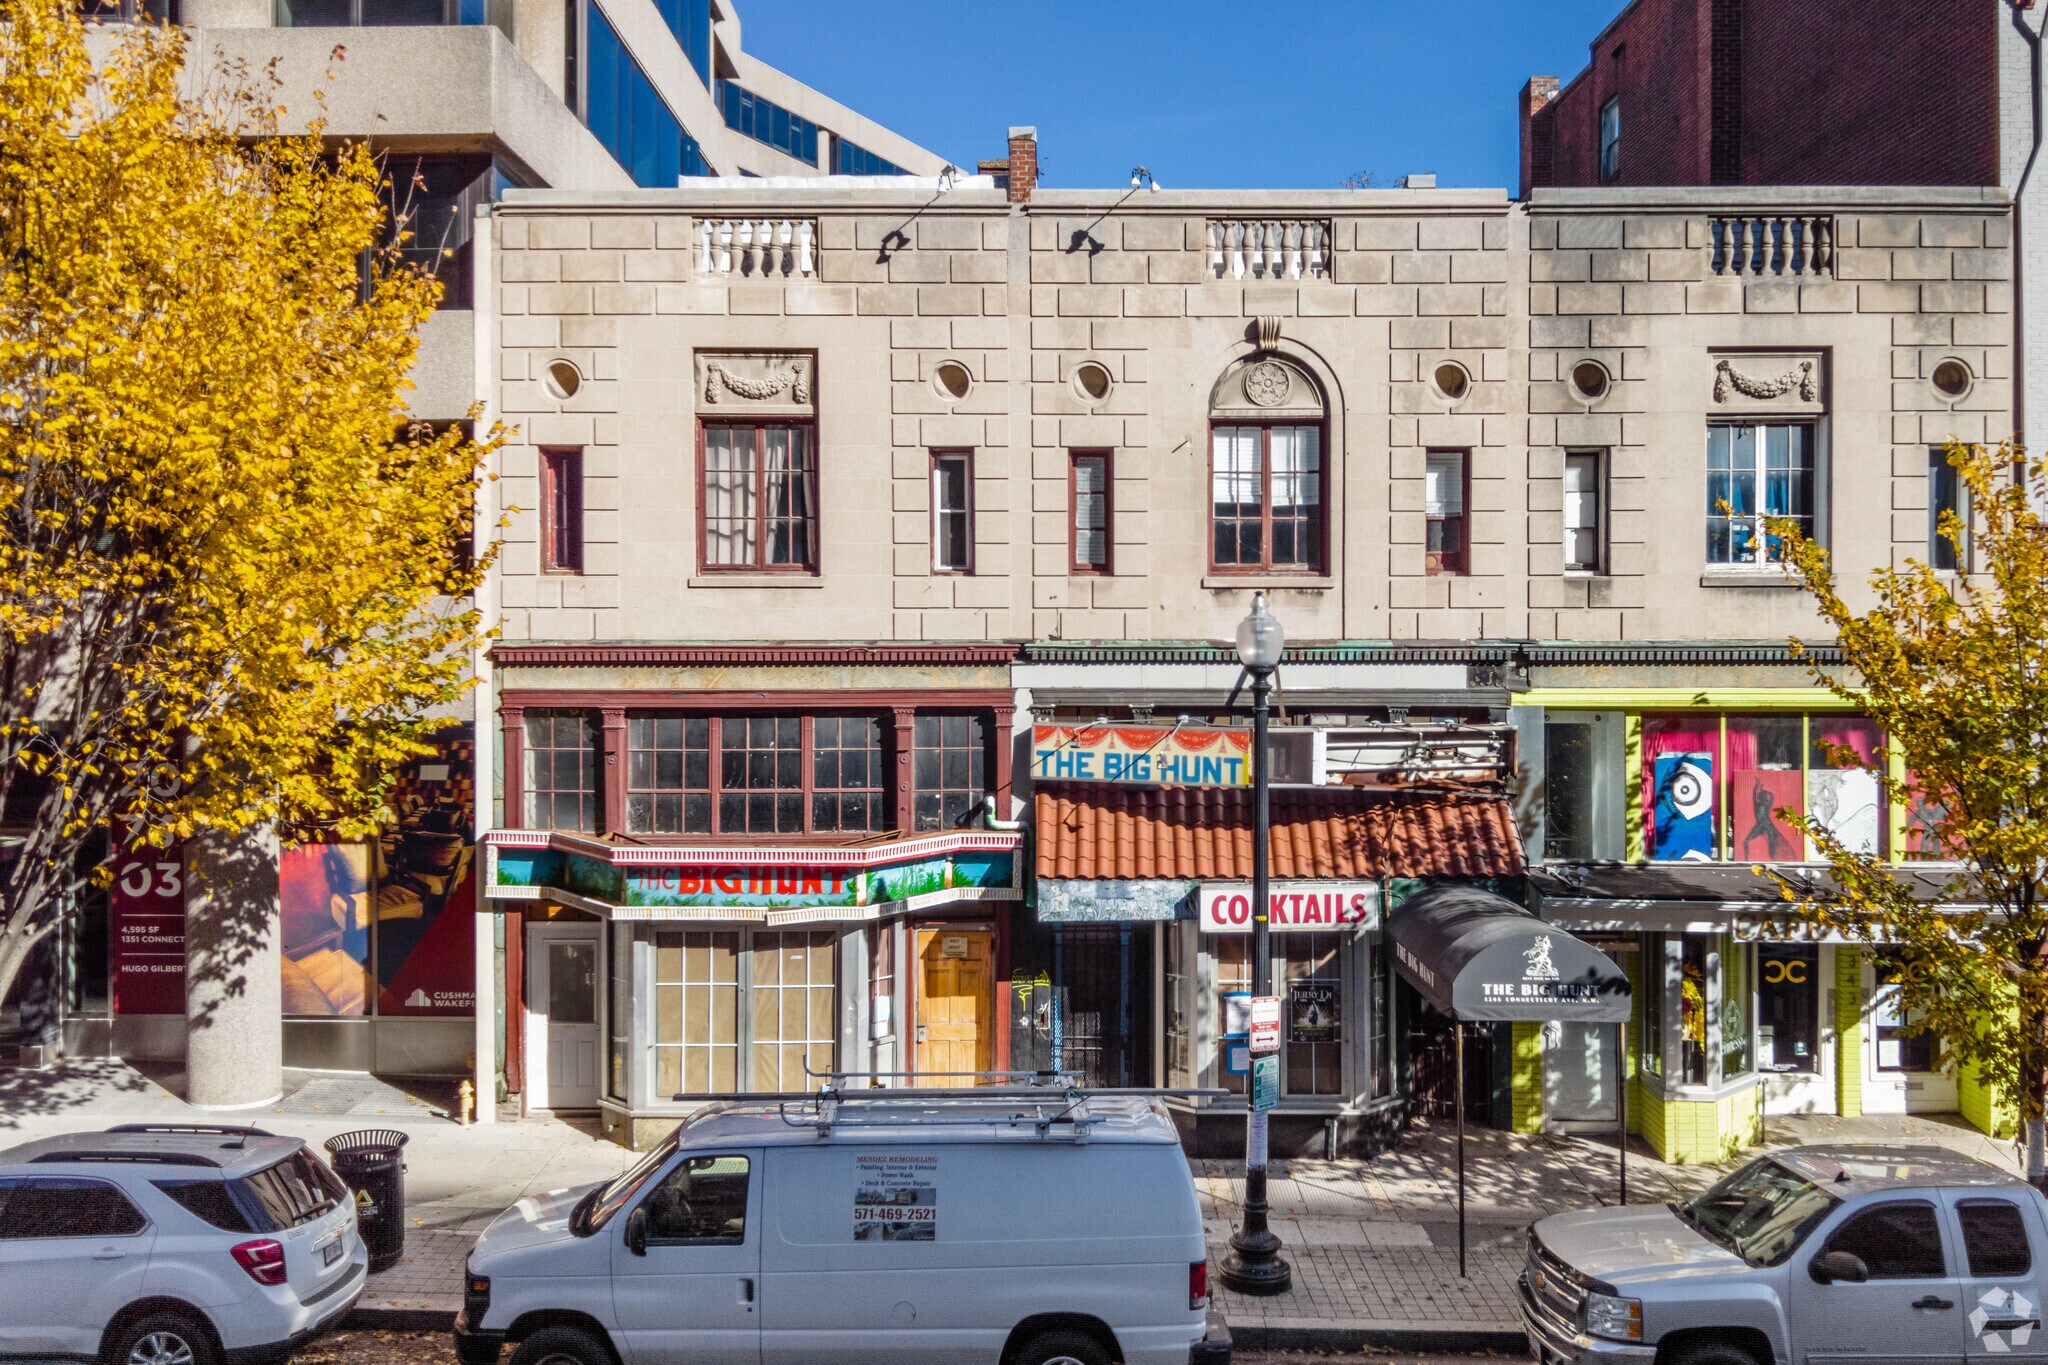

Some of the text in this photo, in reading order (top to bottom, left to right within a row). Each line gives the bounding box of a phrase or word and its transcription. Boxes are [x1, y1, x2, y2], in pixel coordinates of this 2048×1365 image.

[1036, 750, 1243, 785] THE BIG HUNT
[120, 862, 181, 898] 03
[678, 866, 744, 895] BIG
[749, 866, 845, 895] HUNT
[1211, 893, 1367, 925] COKTAILS
[121, 965, 149, 973] HUGO
[1396, 941, 1434, 988] THE BIG HUNT
[1482, 984, 1601, 997] THE BIG HUNT
[855, 1208, 936, 1220] 571-469-2521
